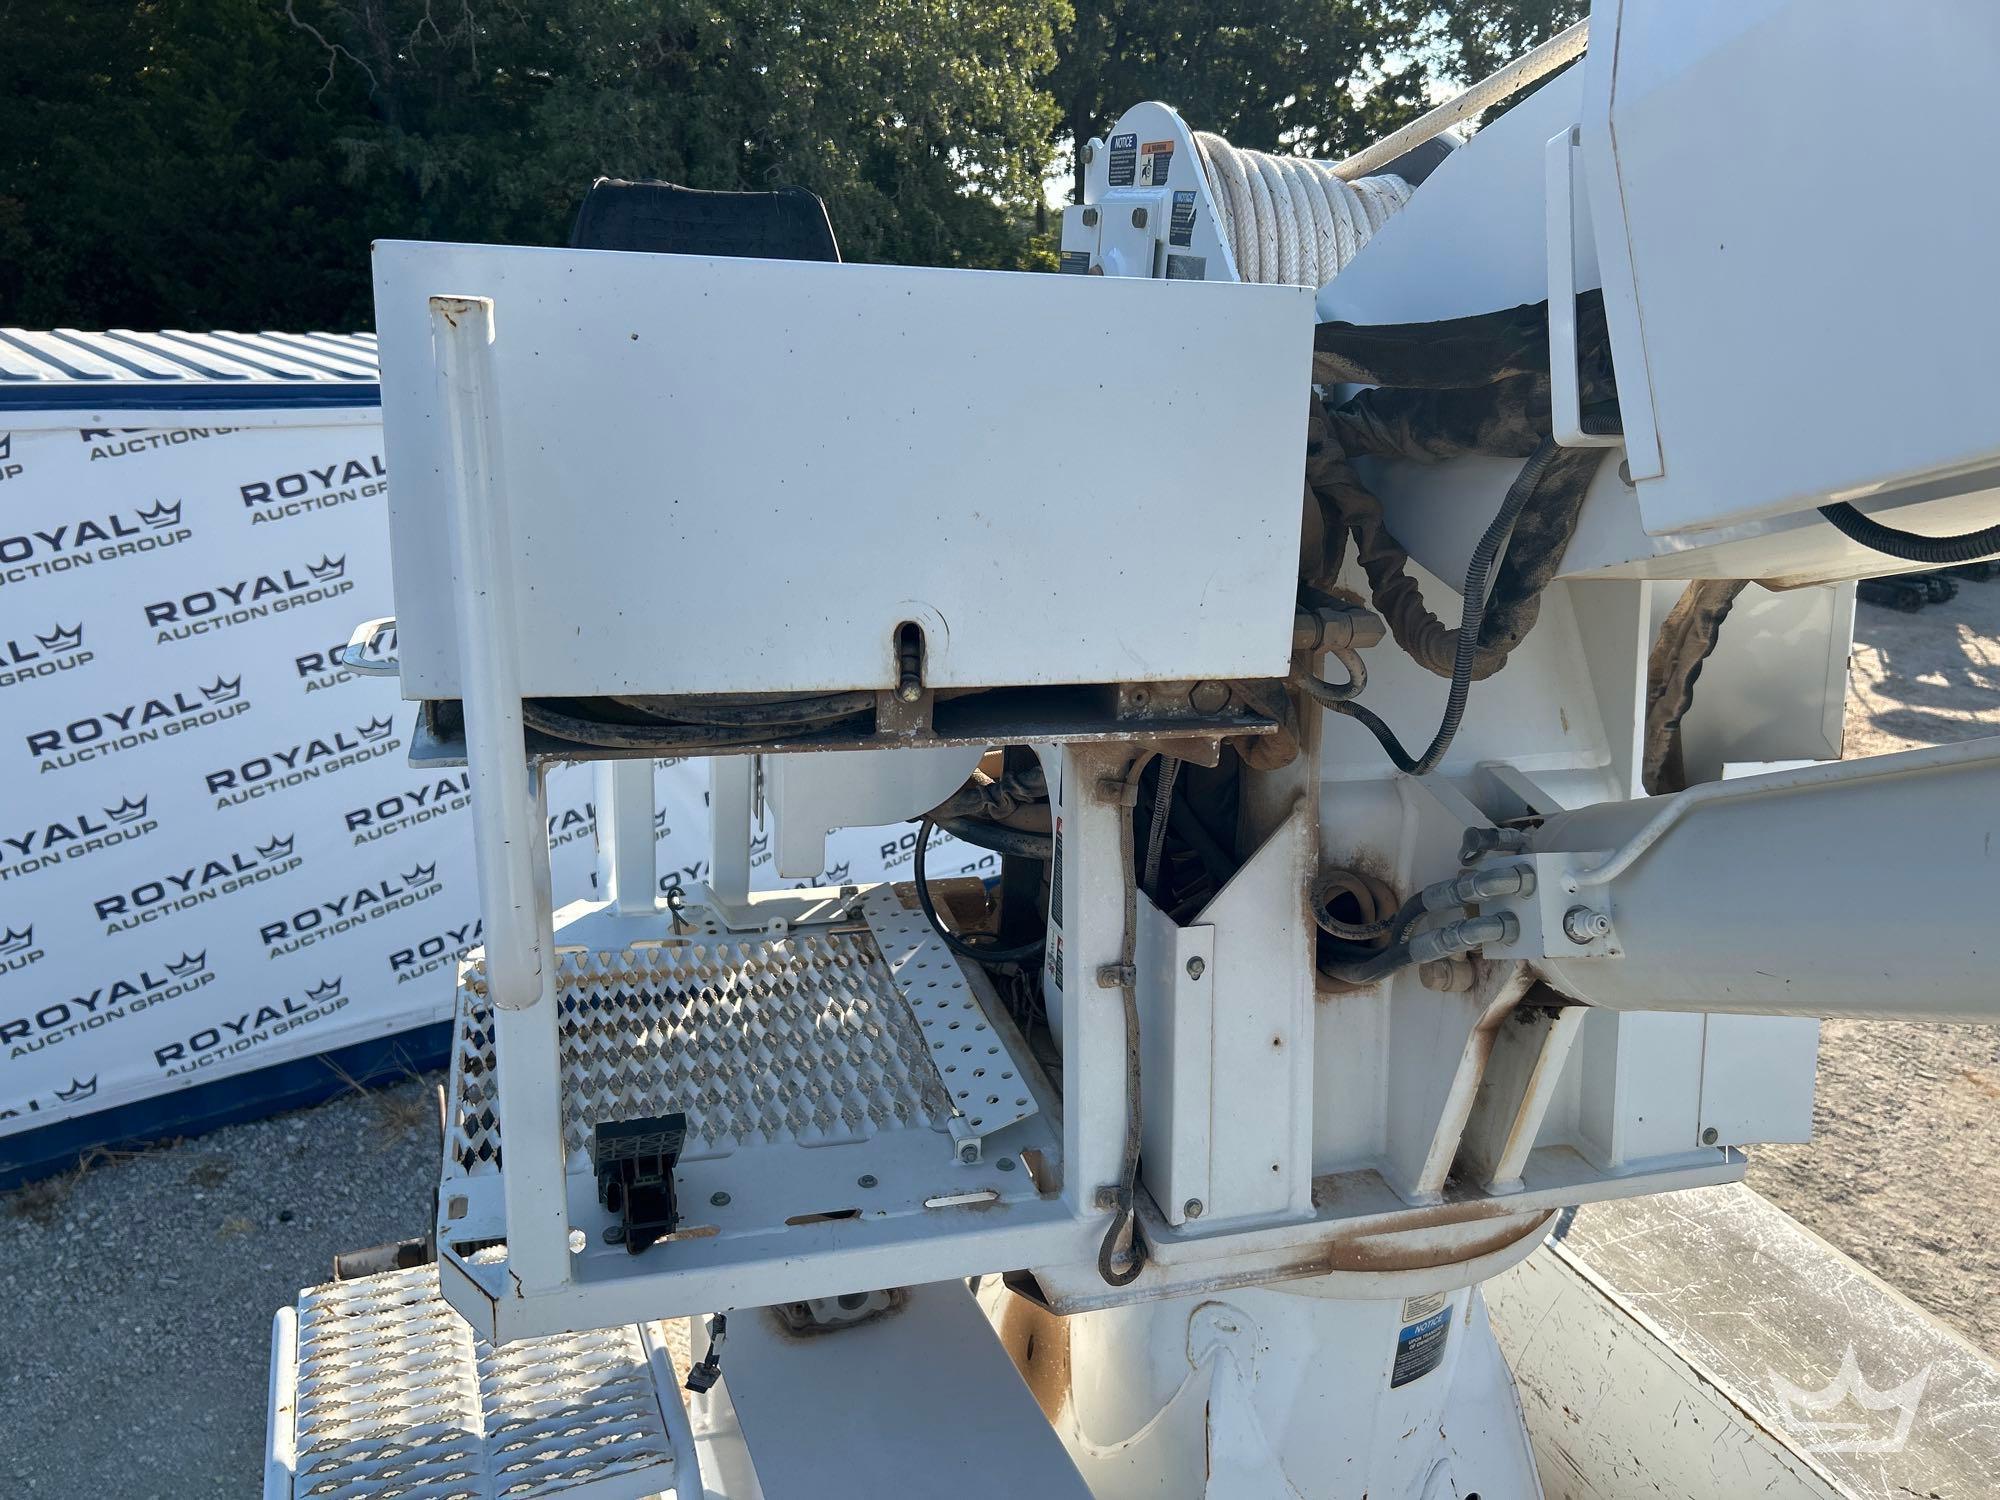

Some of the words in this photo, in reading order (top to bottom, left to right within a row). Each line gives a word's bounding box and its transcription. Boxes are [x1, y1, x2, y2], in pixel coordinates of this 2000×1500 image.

[1114, 136, 1133, 149] NOTICE
[90, 427, 209, 462] AUCTION
[252, 489, 357, 525] AUCTION
[0, 552, 93, 586] CTION
[98, 529, 192, 560] GROUP
[144, 569, 310, 628] ROYAL
[157, 604, 269, 645] AUCTION
[272, 580, 354, 613] GROUP
[0, 651, 94, 687] GROUP
[26, 693, 203, 757] ROYAL
[40, 728, 158, 774] AUCTION
[163, 701, 251, 736] GROUP
[205, 733, 359, 794] ROYAL
[217, 766, 320, 811] AUCTION
[324, 738, 400, 774] GROUP
[66, 820, 159, 859] GROUP
[354, 804, 447, 847] AUCTION
[93, 853, 258, 921] ROYAL
[106, 887, 217, 936] AUCTION
[221, 856, 303, 894] GROUP
[259, 880, 403, 946] ROYAL
[269, 912, 367, 960] AUCTION
[370, 882, 443, 919] GROUP
[0, 971, 168, 1045] ROYAL
[10, 1006, 125, 1060] AUCTION
[129, 972, 216, 1013] GROUP
[154, 996, 308, 1068] ROYAL
[166, 1030, 269, 1077] AUCTION
[272, 997, 349, 1036] GROUP
[1414, 1313, 1444, 1334] NOTICE
